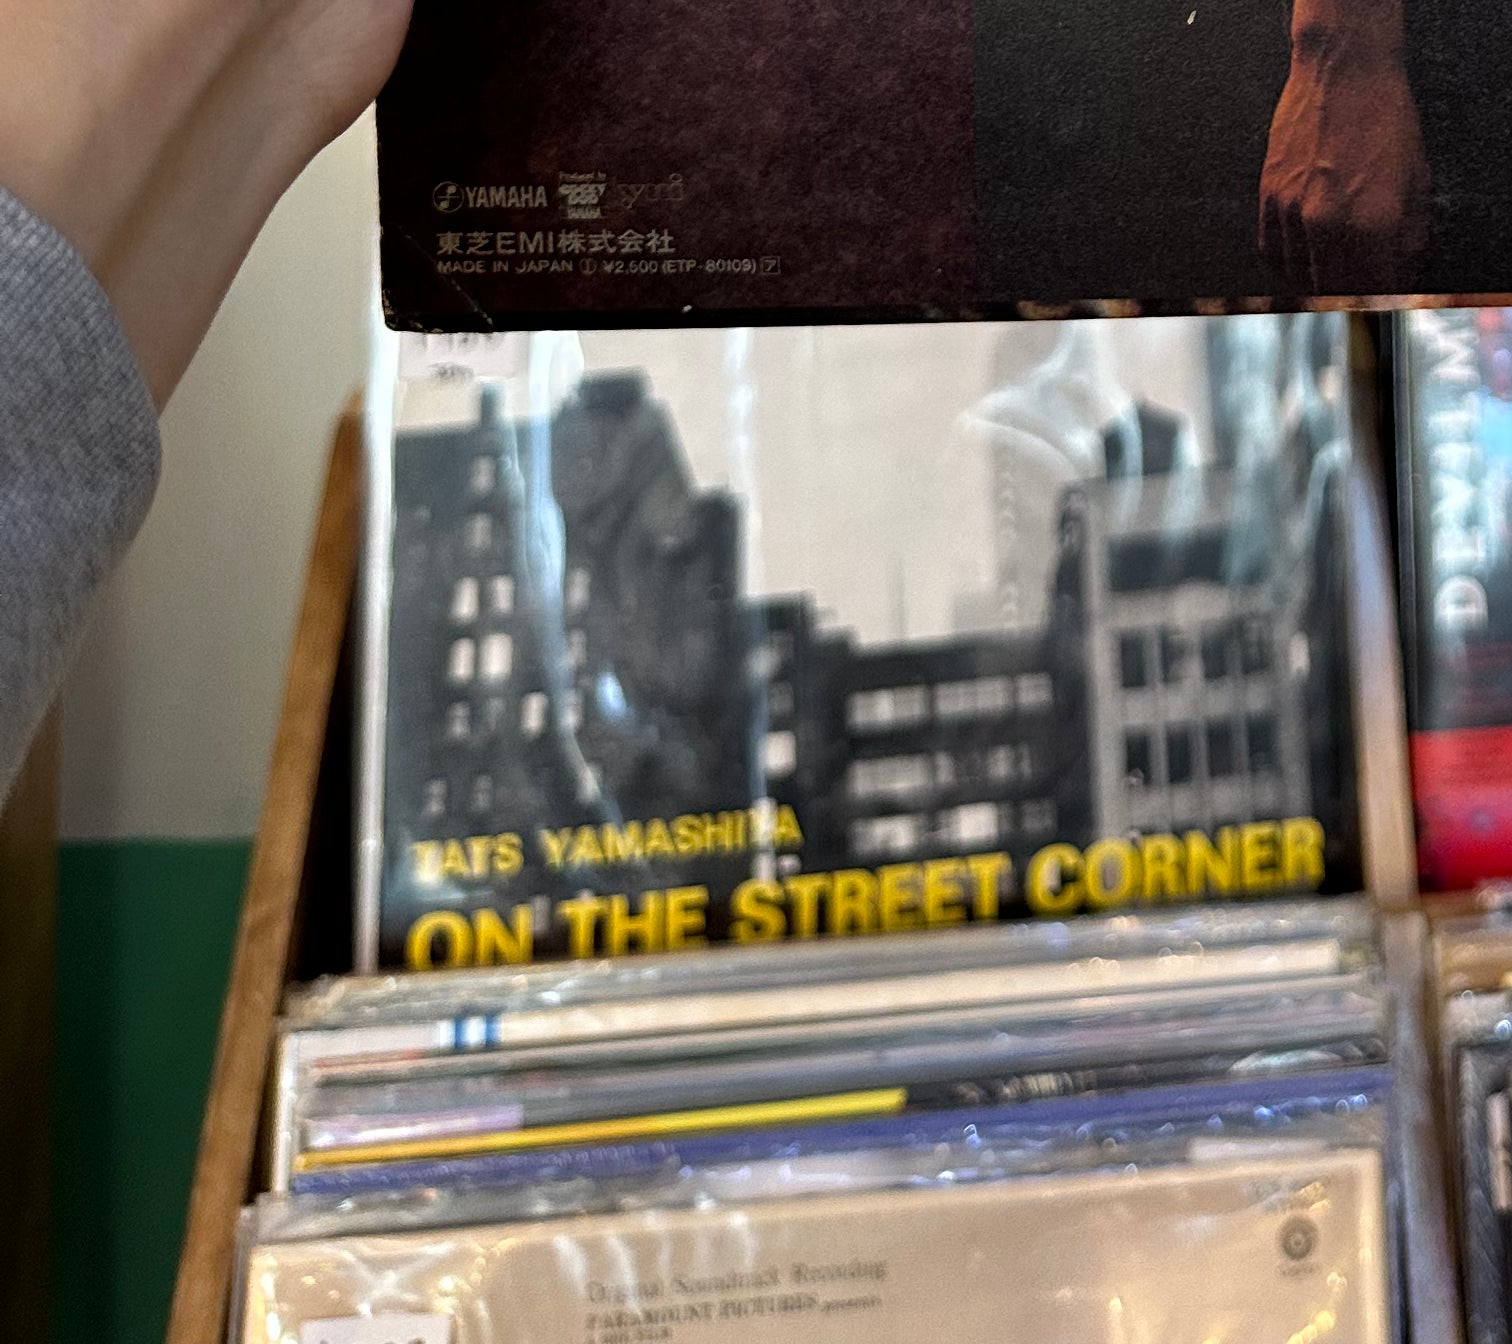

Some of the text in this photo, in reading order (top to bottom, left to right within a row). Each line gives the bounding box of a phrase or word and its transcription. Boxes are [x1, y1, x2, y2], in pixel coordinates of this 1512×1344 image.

[465, 185, 548, 209] YAMAHA
[436, 228, 677, 256] 東芝EMI株式会社
[437, 260, 486, 274] MADE
[493, 260, 510, 273] IN
[515, 259, 574, 274] JAPAN
[406, 815, 1326, 972] ON THE STREET CORNER
